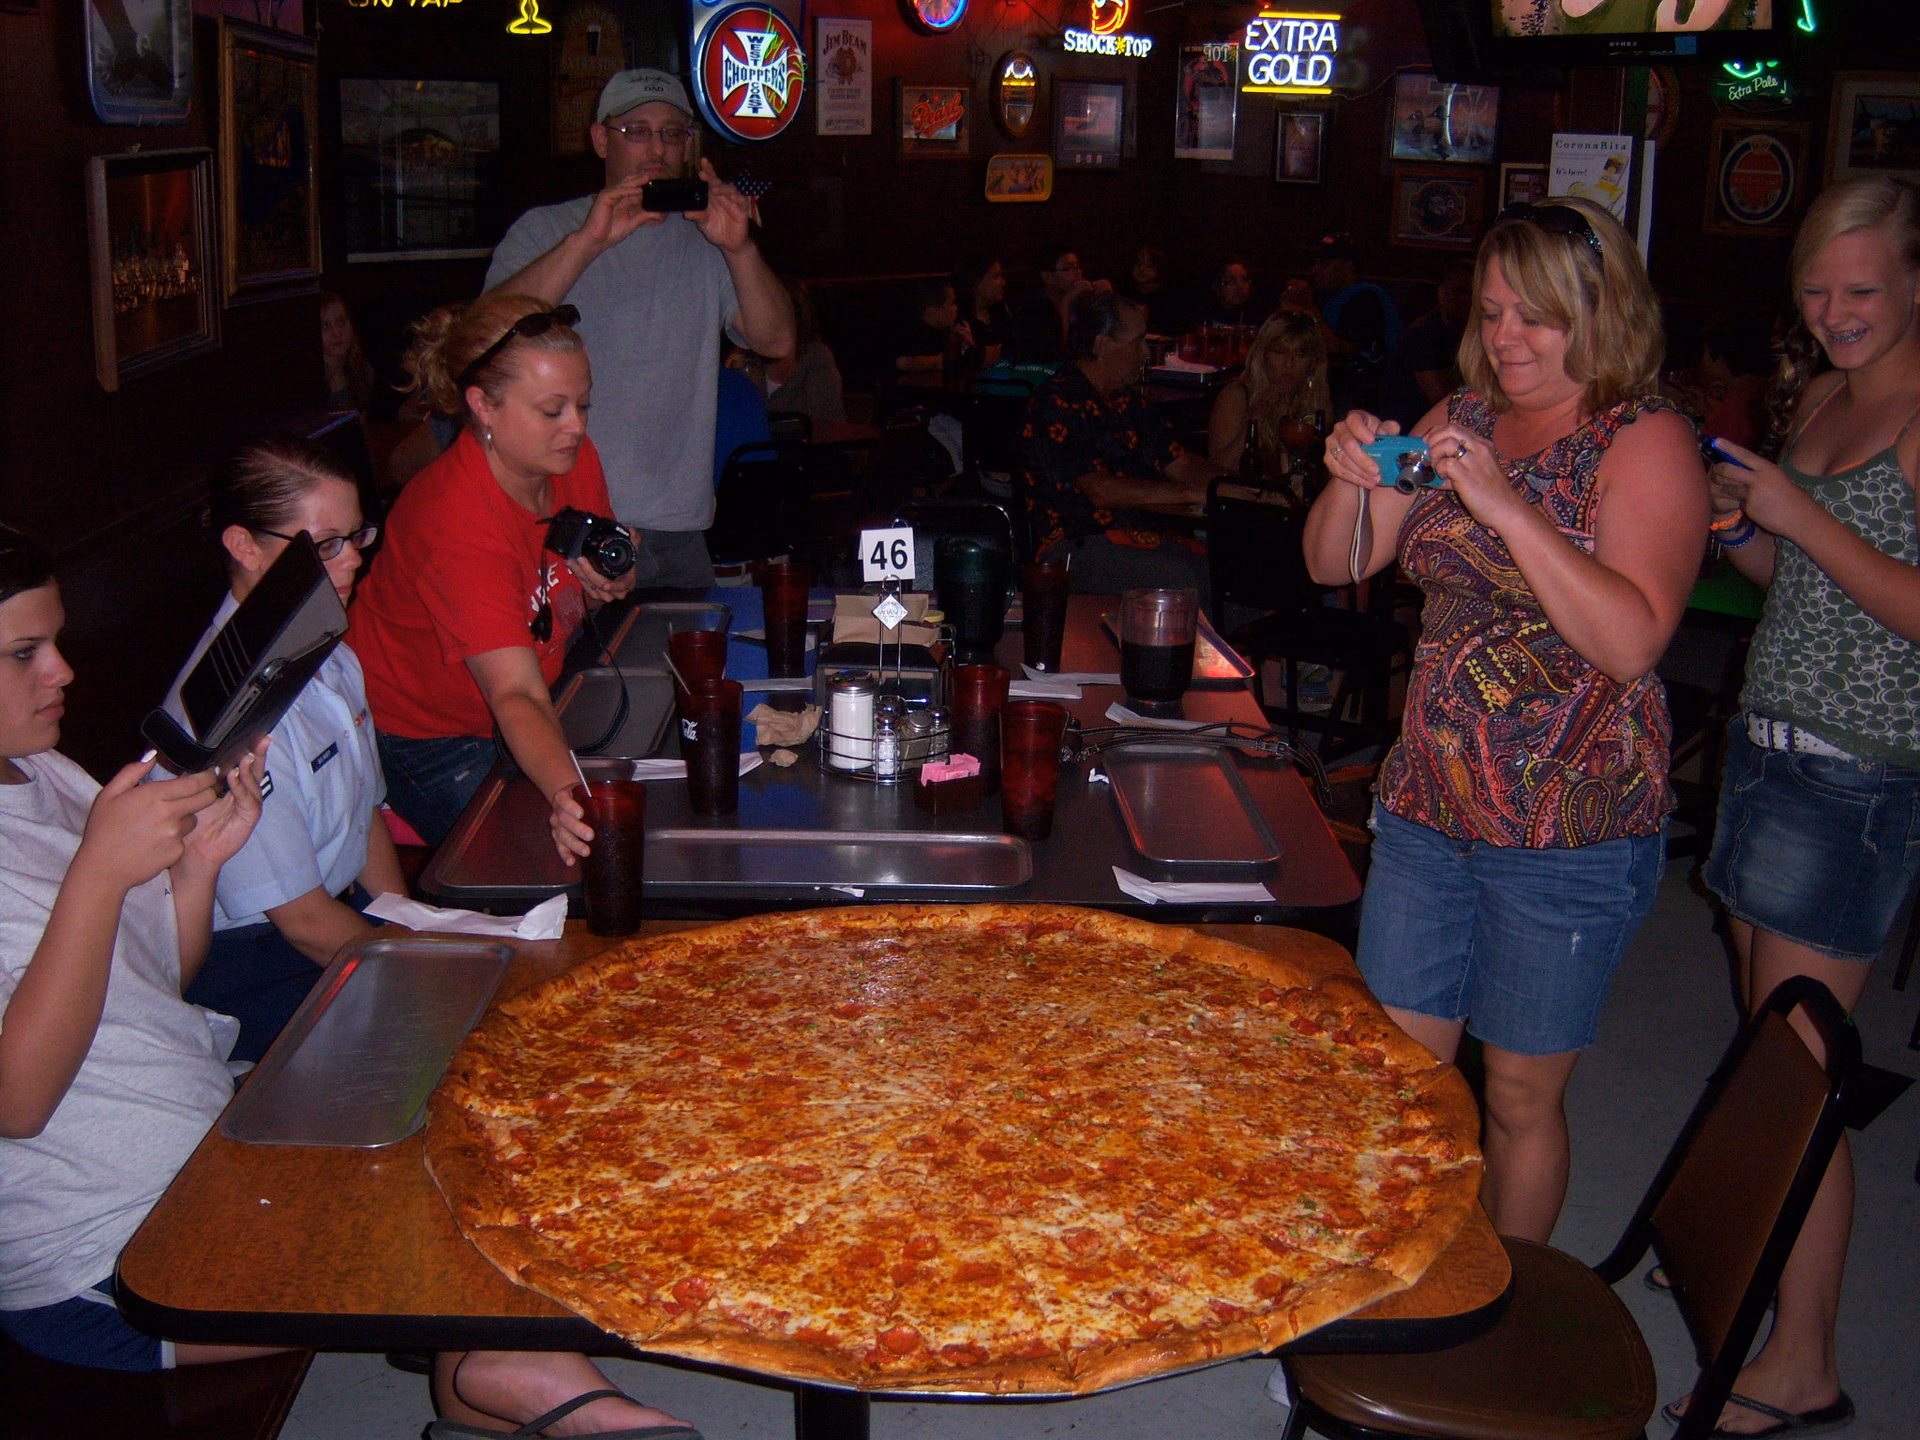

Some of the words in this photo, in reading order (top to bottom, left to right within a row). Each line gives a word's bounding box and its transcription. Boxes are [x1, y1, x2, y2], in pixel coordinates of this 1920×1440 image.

[747, 35, 765, 66] WEST
[823, 33, 841, 55] JIM
[842, 29, 867, 56] BEAM
[1063, 29, 1117, 55] SHOCK
[1124, 35, 1152, 58] TOP
[1245, 19, 1337, 52] EXTRA
[724, 56, 785, 93] CHOPPERS
[1248, 53, 1331, 86] GOLD
[747, 82, 763, 114] COAST
[1728, 85, 1752, 101] Extra
[1752, 75, 1778, 93] Pale
[1555, 139, 1627, 151] CoronaRita
[870, 538, 908, 570] 46
